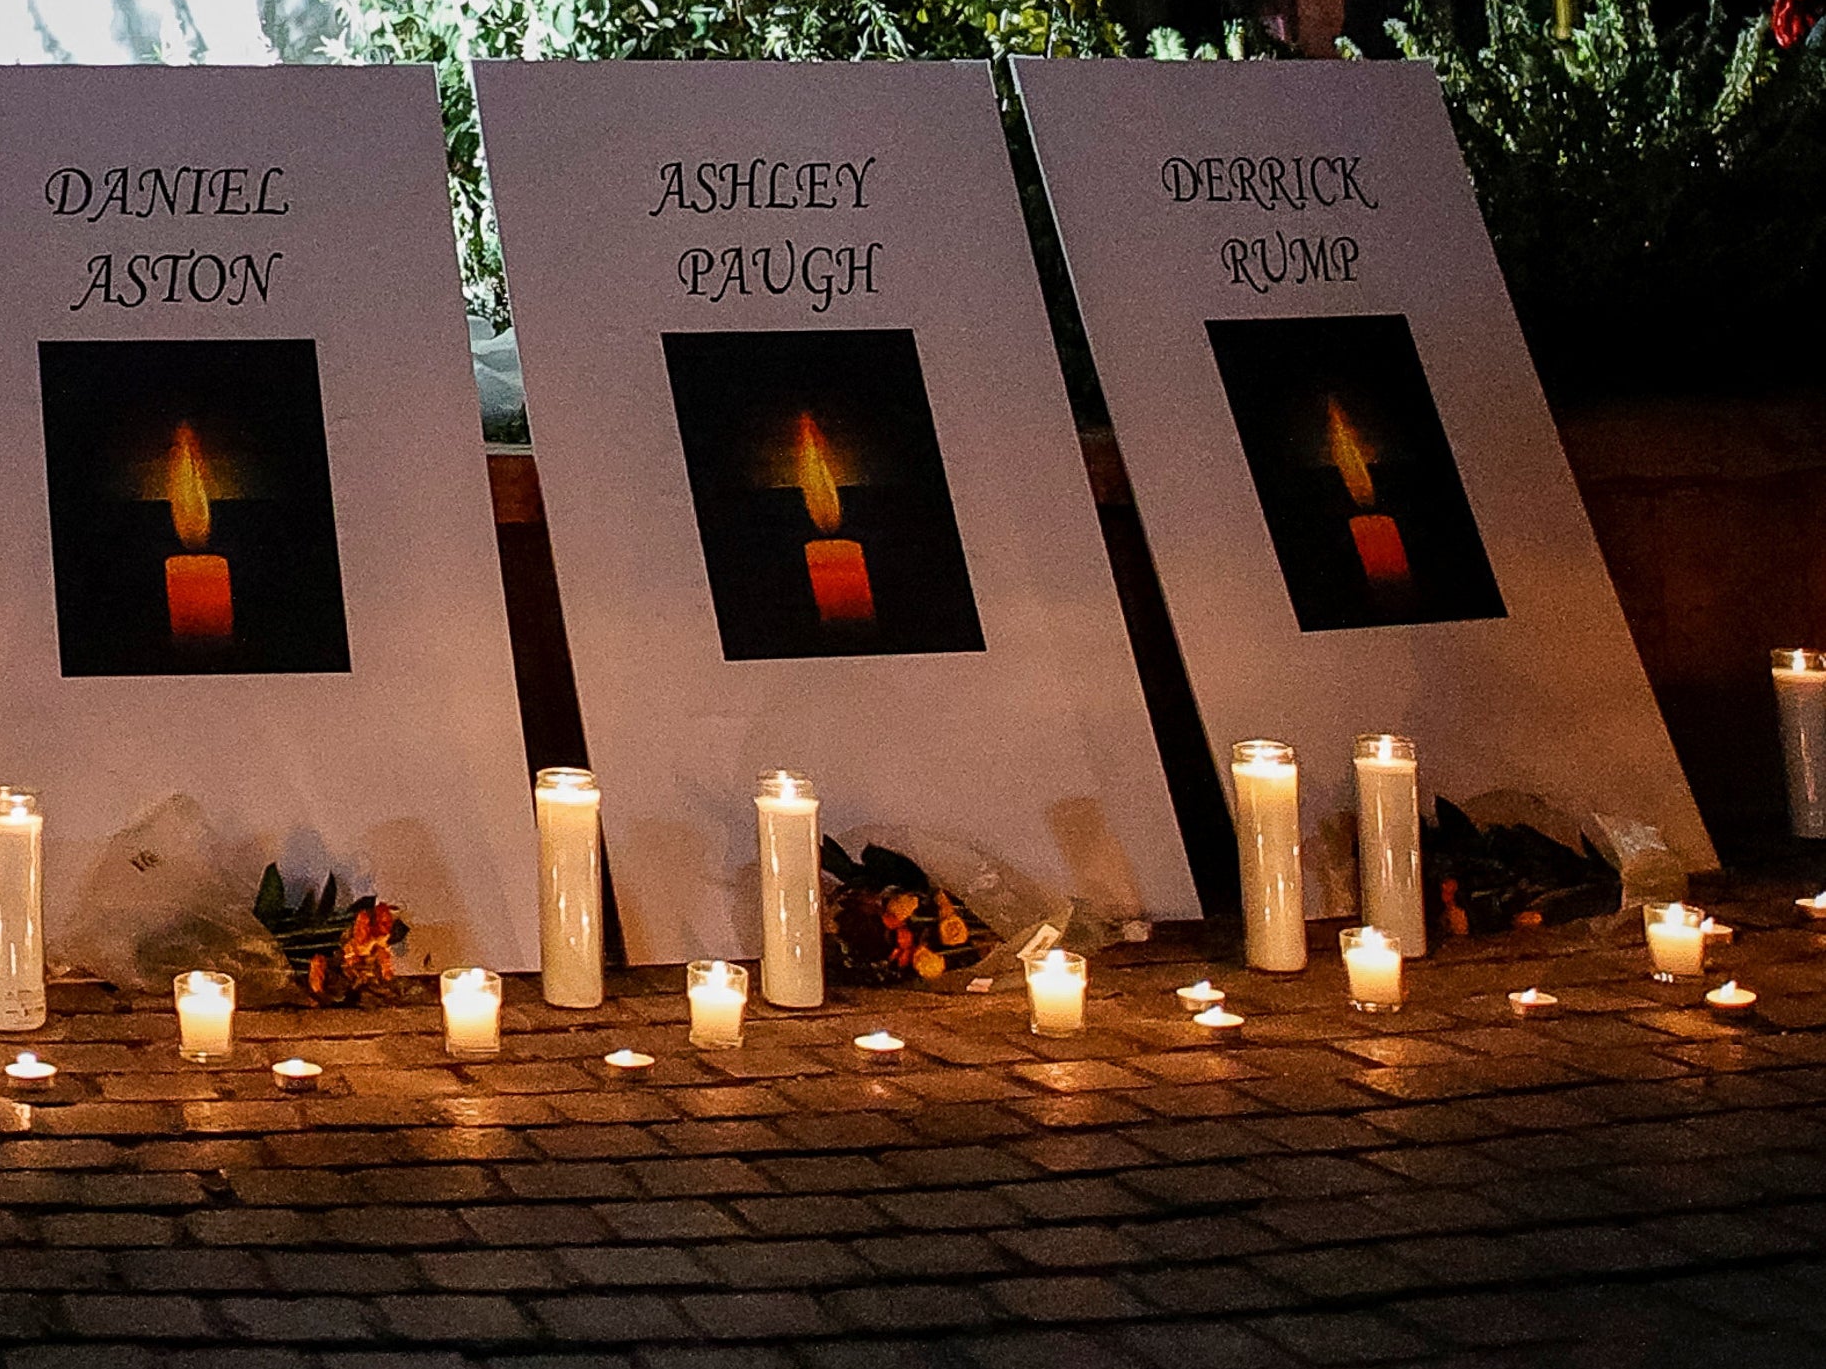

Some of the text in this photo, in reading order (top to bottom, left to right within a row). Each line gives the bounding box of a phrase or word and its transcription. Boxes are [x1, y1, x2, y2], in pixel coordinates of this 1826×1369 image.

[44, 166, 290, 223] DANIEL
[648, 156, 876, 217] ASHLEY
[1161, 156, 1379, 211] DERRICK
[69, 248, 284, 312] ASTON
[677, 239, 884, 313] PAUGH
[1220, 230, 1360, 294] RUMP
